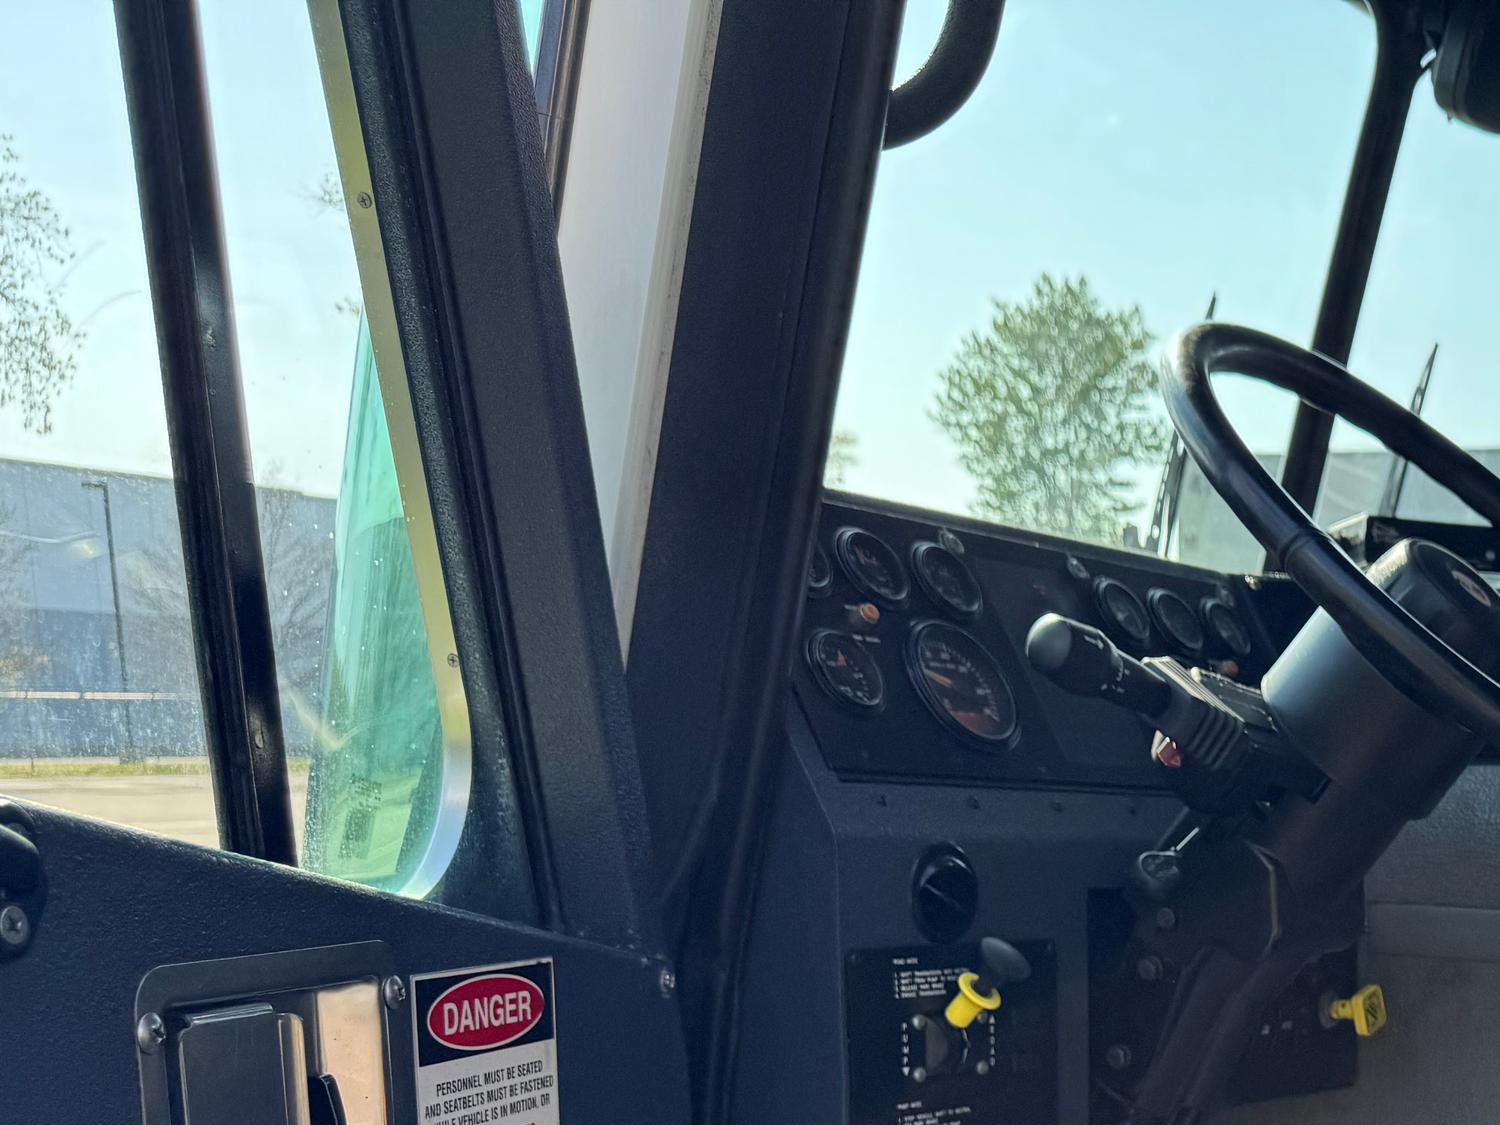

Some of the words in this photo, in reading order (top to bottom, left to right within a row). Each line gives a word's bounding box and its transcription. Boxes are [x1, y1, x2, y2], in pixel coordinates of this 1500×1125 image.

[443, 990, 532, 1036] DANGER
[425, 1103, 441, 1119] AND
[443, 1092, 485, 1114] SEATBELTS
[486, 1086, 507, 1103] MUST
[509, 1084, 518, 1097] BE
[520, 1075, 554, 1095] FASTENED
[436, 1075, 482, 1097] PERSONNEL
[484, 1068, 505, 1085] MUST
[507, 1066, 516, 1079] BE
[517, 1060, 543, 1077] SEATED
[491, 1106, 499, 1120] IS
[500, 1104, 508, 1118] IN
[540, 1093, 551, 1107] OR
